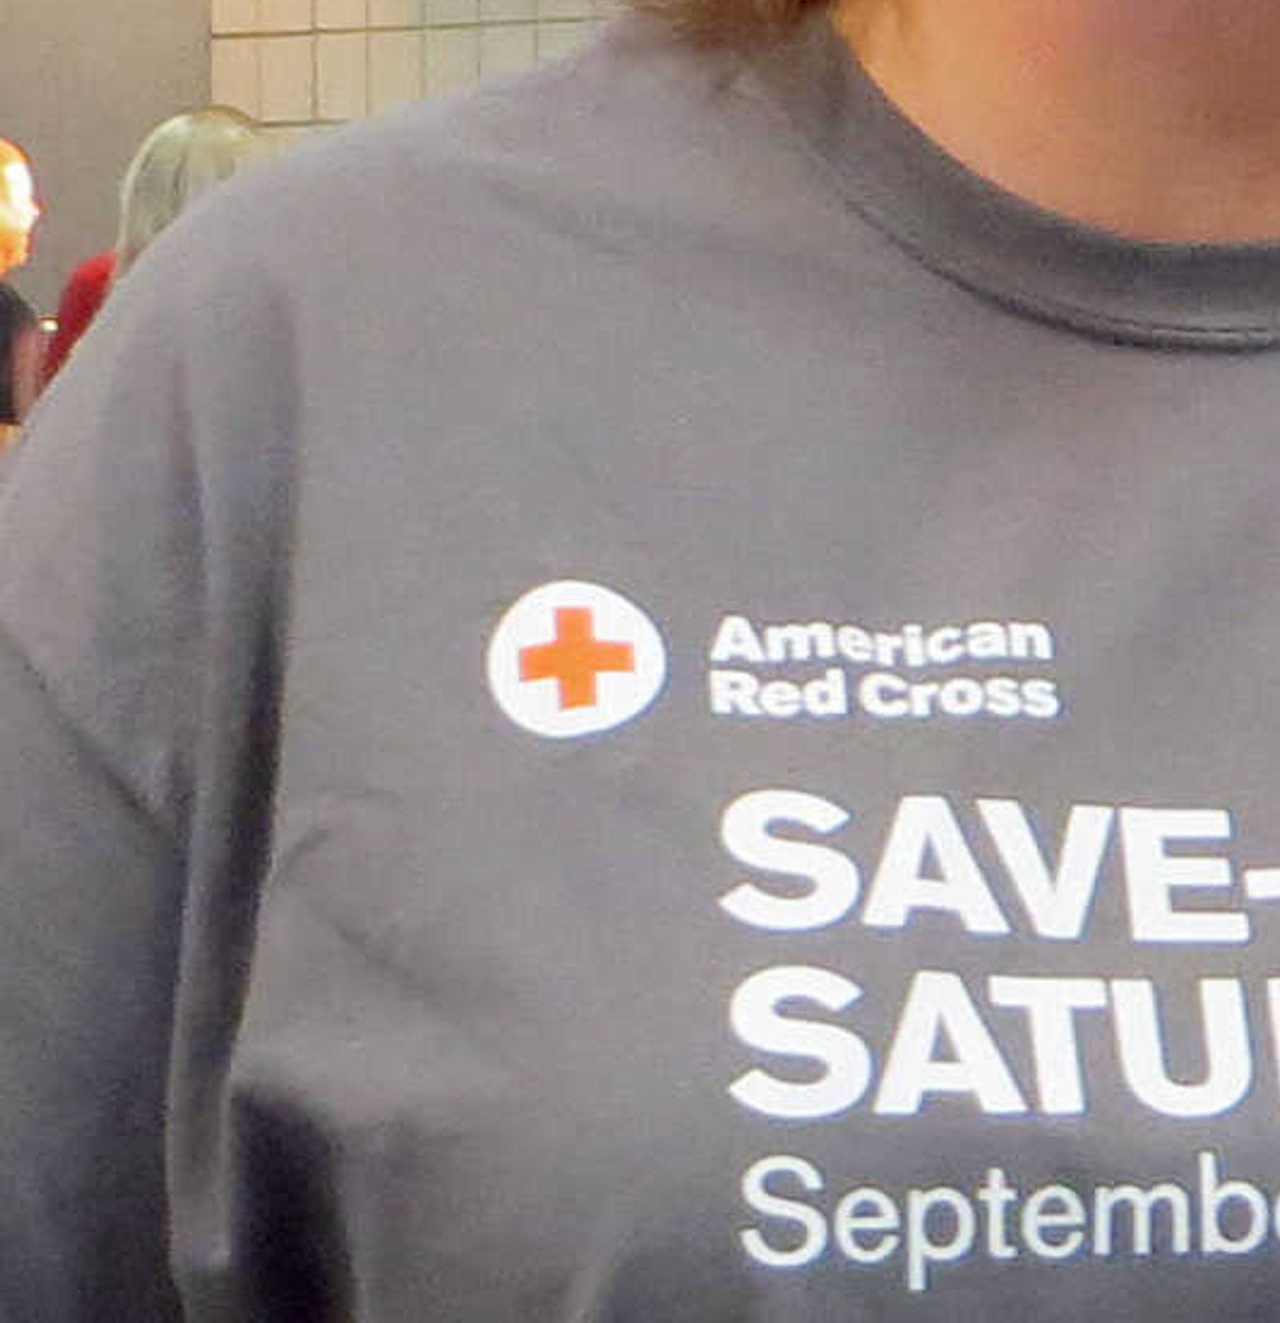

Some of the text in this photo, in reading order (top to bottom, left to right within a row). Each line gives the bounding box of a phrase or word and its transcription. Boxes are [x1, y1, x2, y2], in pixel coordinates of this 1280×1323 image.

[709, 615, 1053, 667] American
[709, 668, 1060, 719] Red Cross
